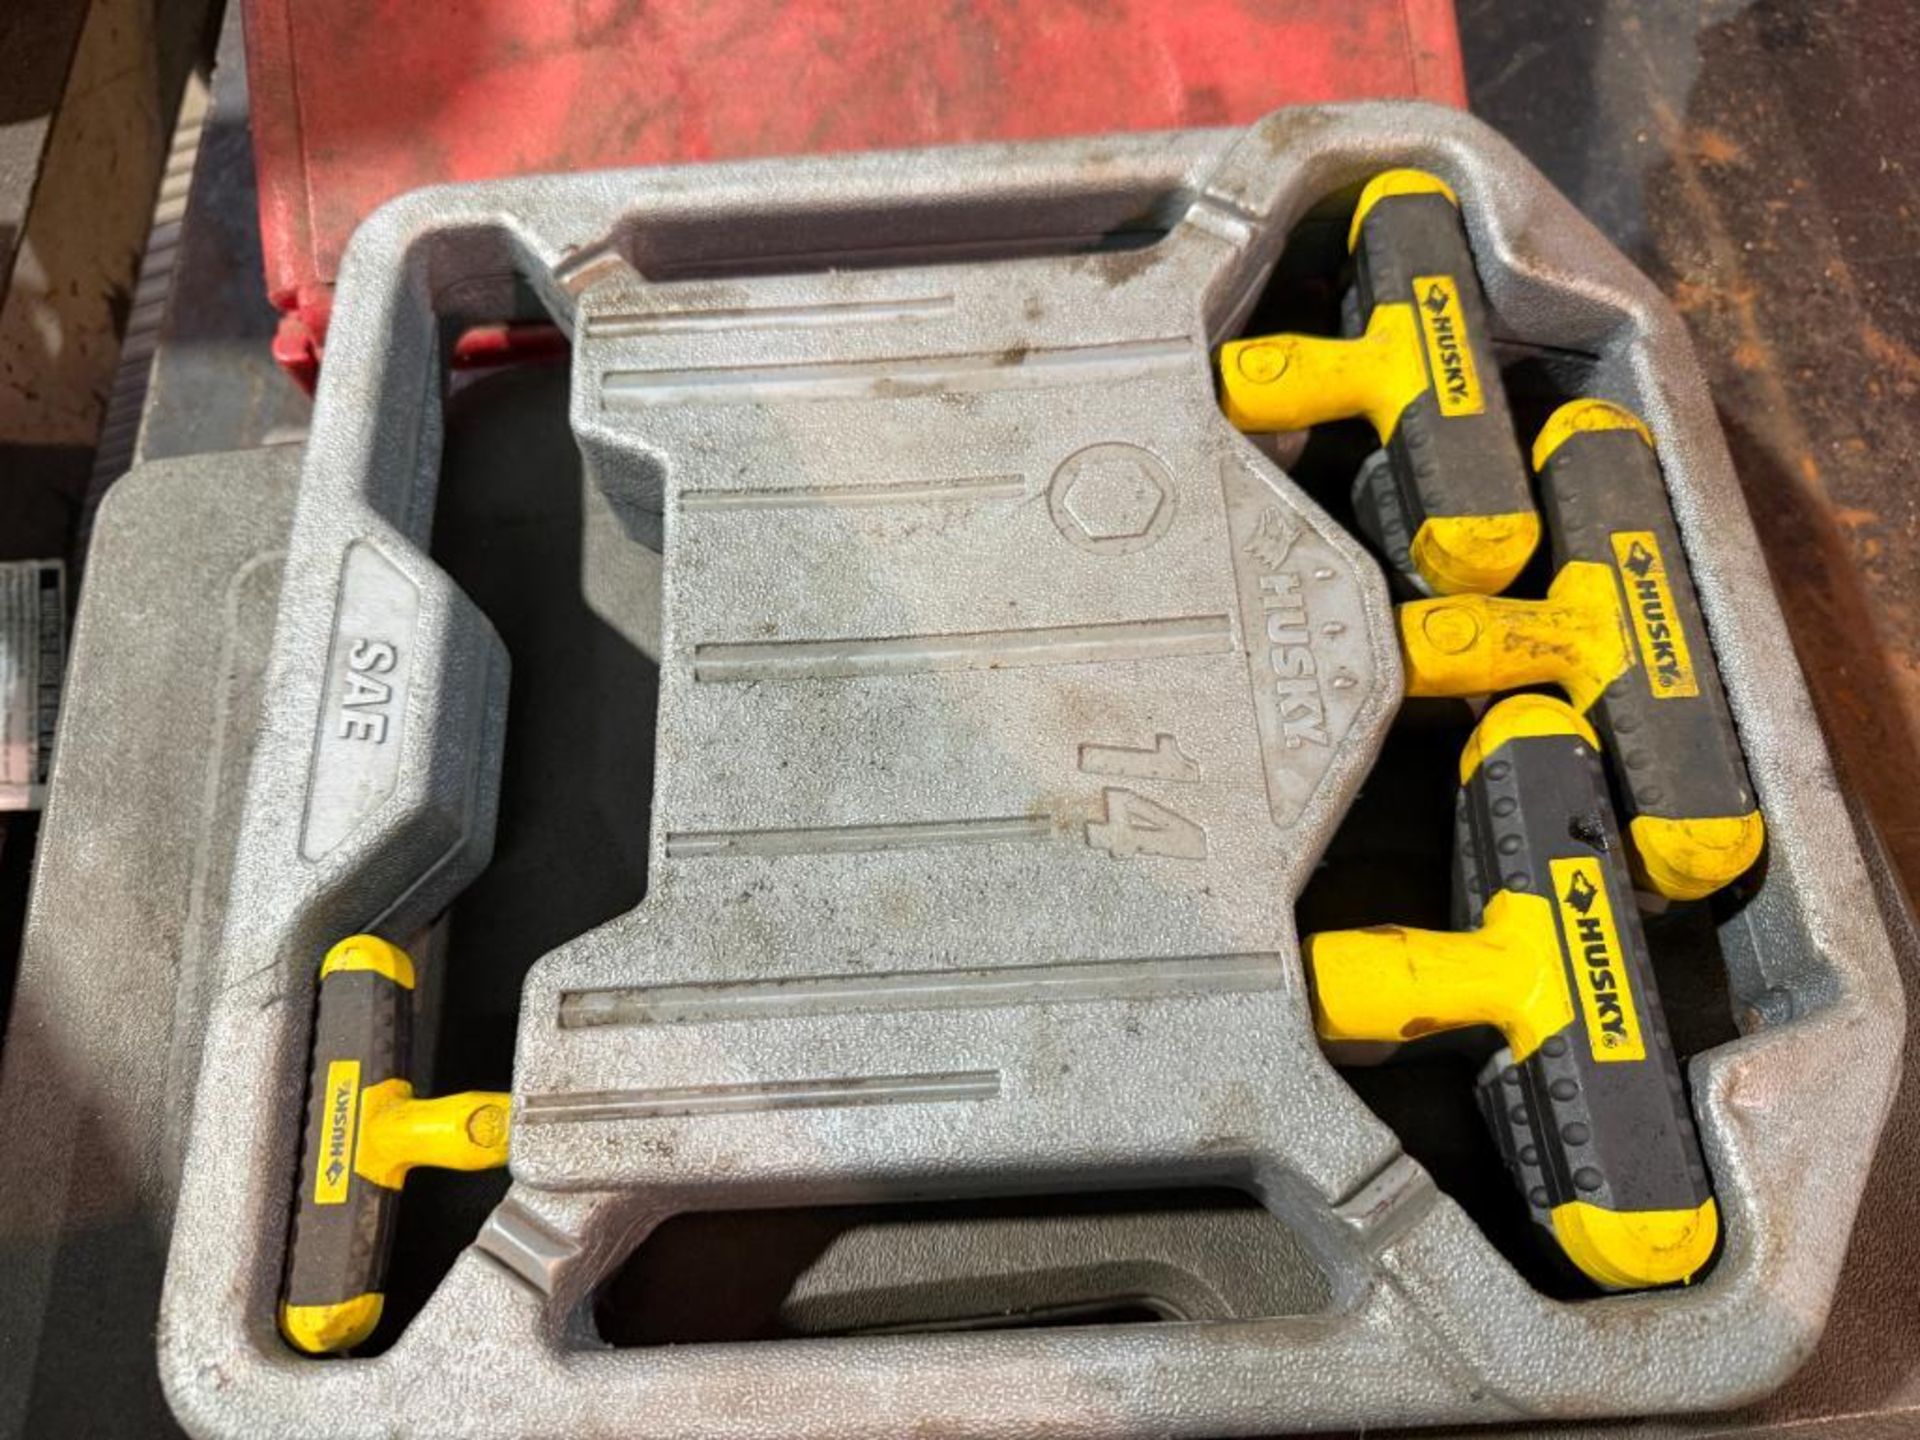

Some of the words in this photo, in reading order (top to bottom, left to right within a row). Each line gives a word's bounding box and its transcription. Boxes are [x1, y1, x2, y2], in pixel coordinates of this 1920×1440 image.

[1431, 316, 1469, 399] HUSKY
[1258, 573, 1330, 749] HUSKY
[1635, 579, 1681, 680] HUSKY
[339, 637, 398, 745] SAE
[1077, 732, 1207, 861] 14
[1576, 916, 1628, 1040] HUSKY
[329, 1087, 351, 1157] HUSKY
